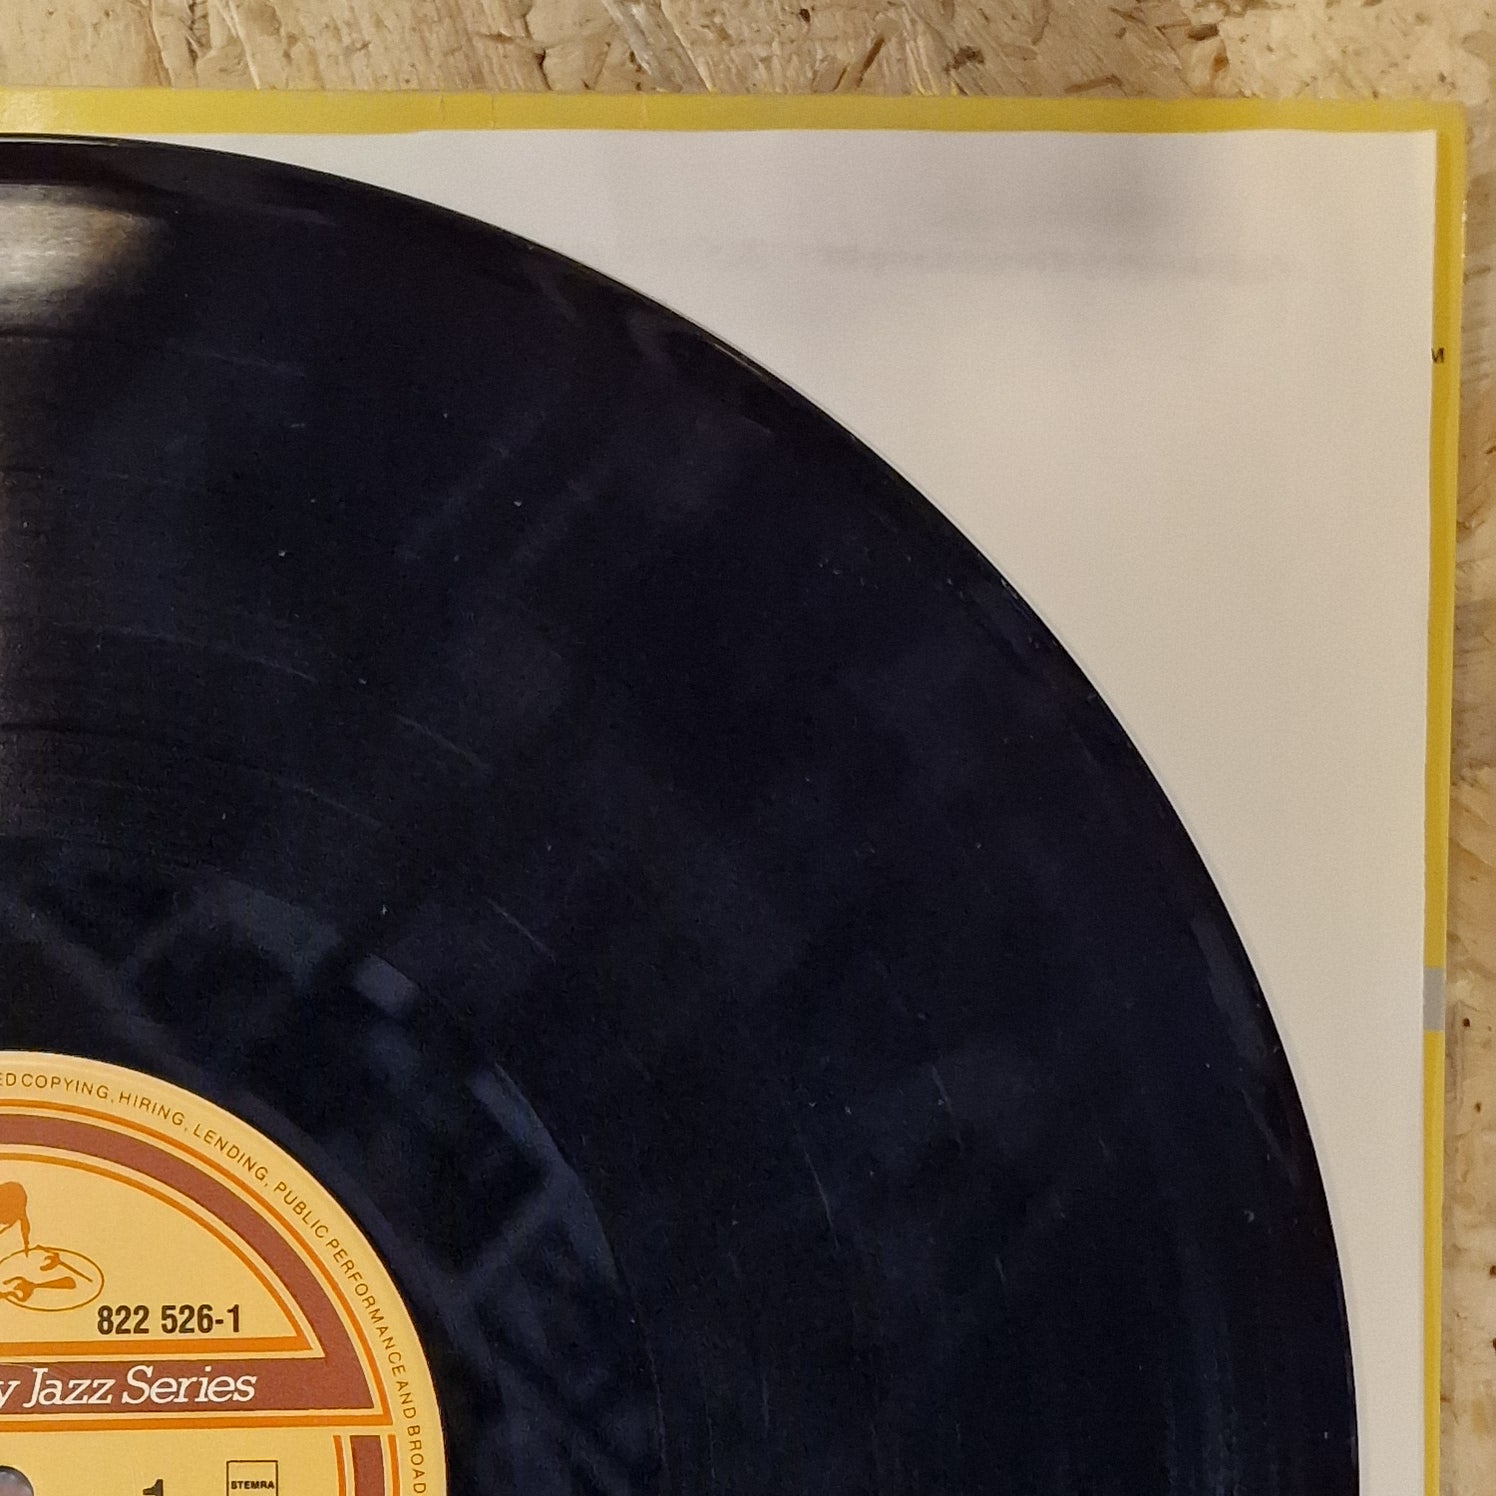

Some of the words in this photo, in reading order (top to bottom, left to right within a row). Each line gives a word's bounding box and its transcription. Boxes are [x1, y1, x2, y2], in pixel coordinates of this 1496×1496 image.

[272, 1180, 329, 1239] PUBLIC
[324, 1237, 407, 1377] PERFORMANCE
[394, 1379, 417, 1419] AND
[96, 1304, 150, 1336] 822
[160, 1303, 240, 1335] 526-1
[22, 1367, 116, 1408] Jazz
[121, 1365, 258, 1404] Series
[230, 1480, 276, 1490] STEMRA
